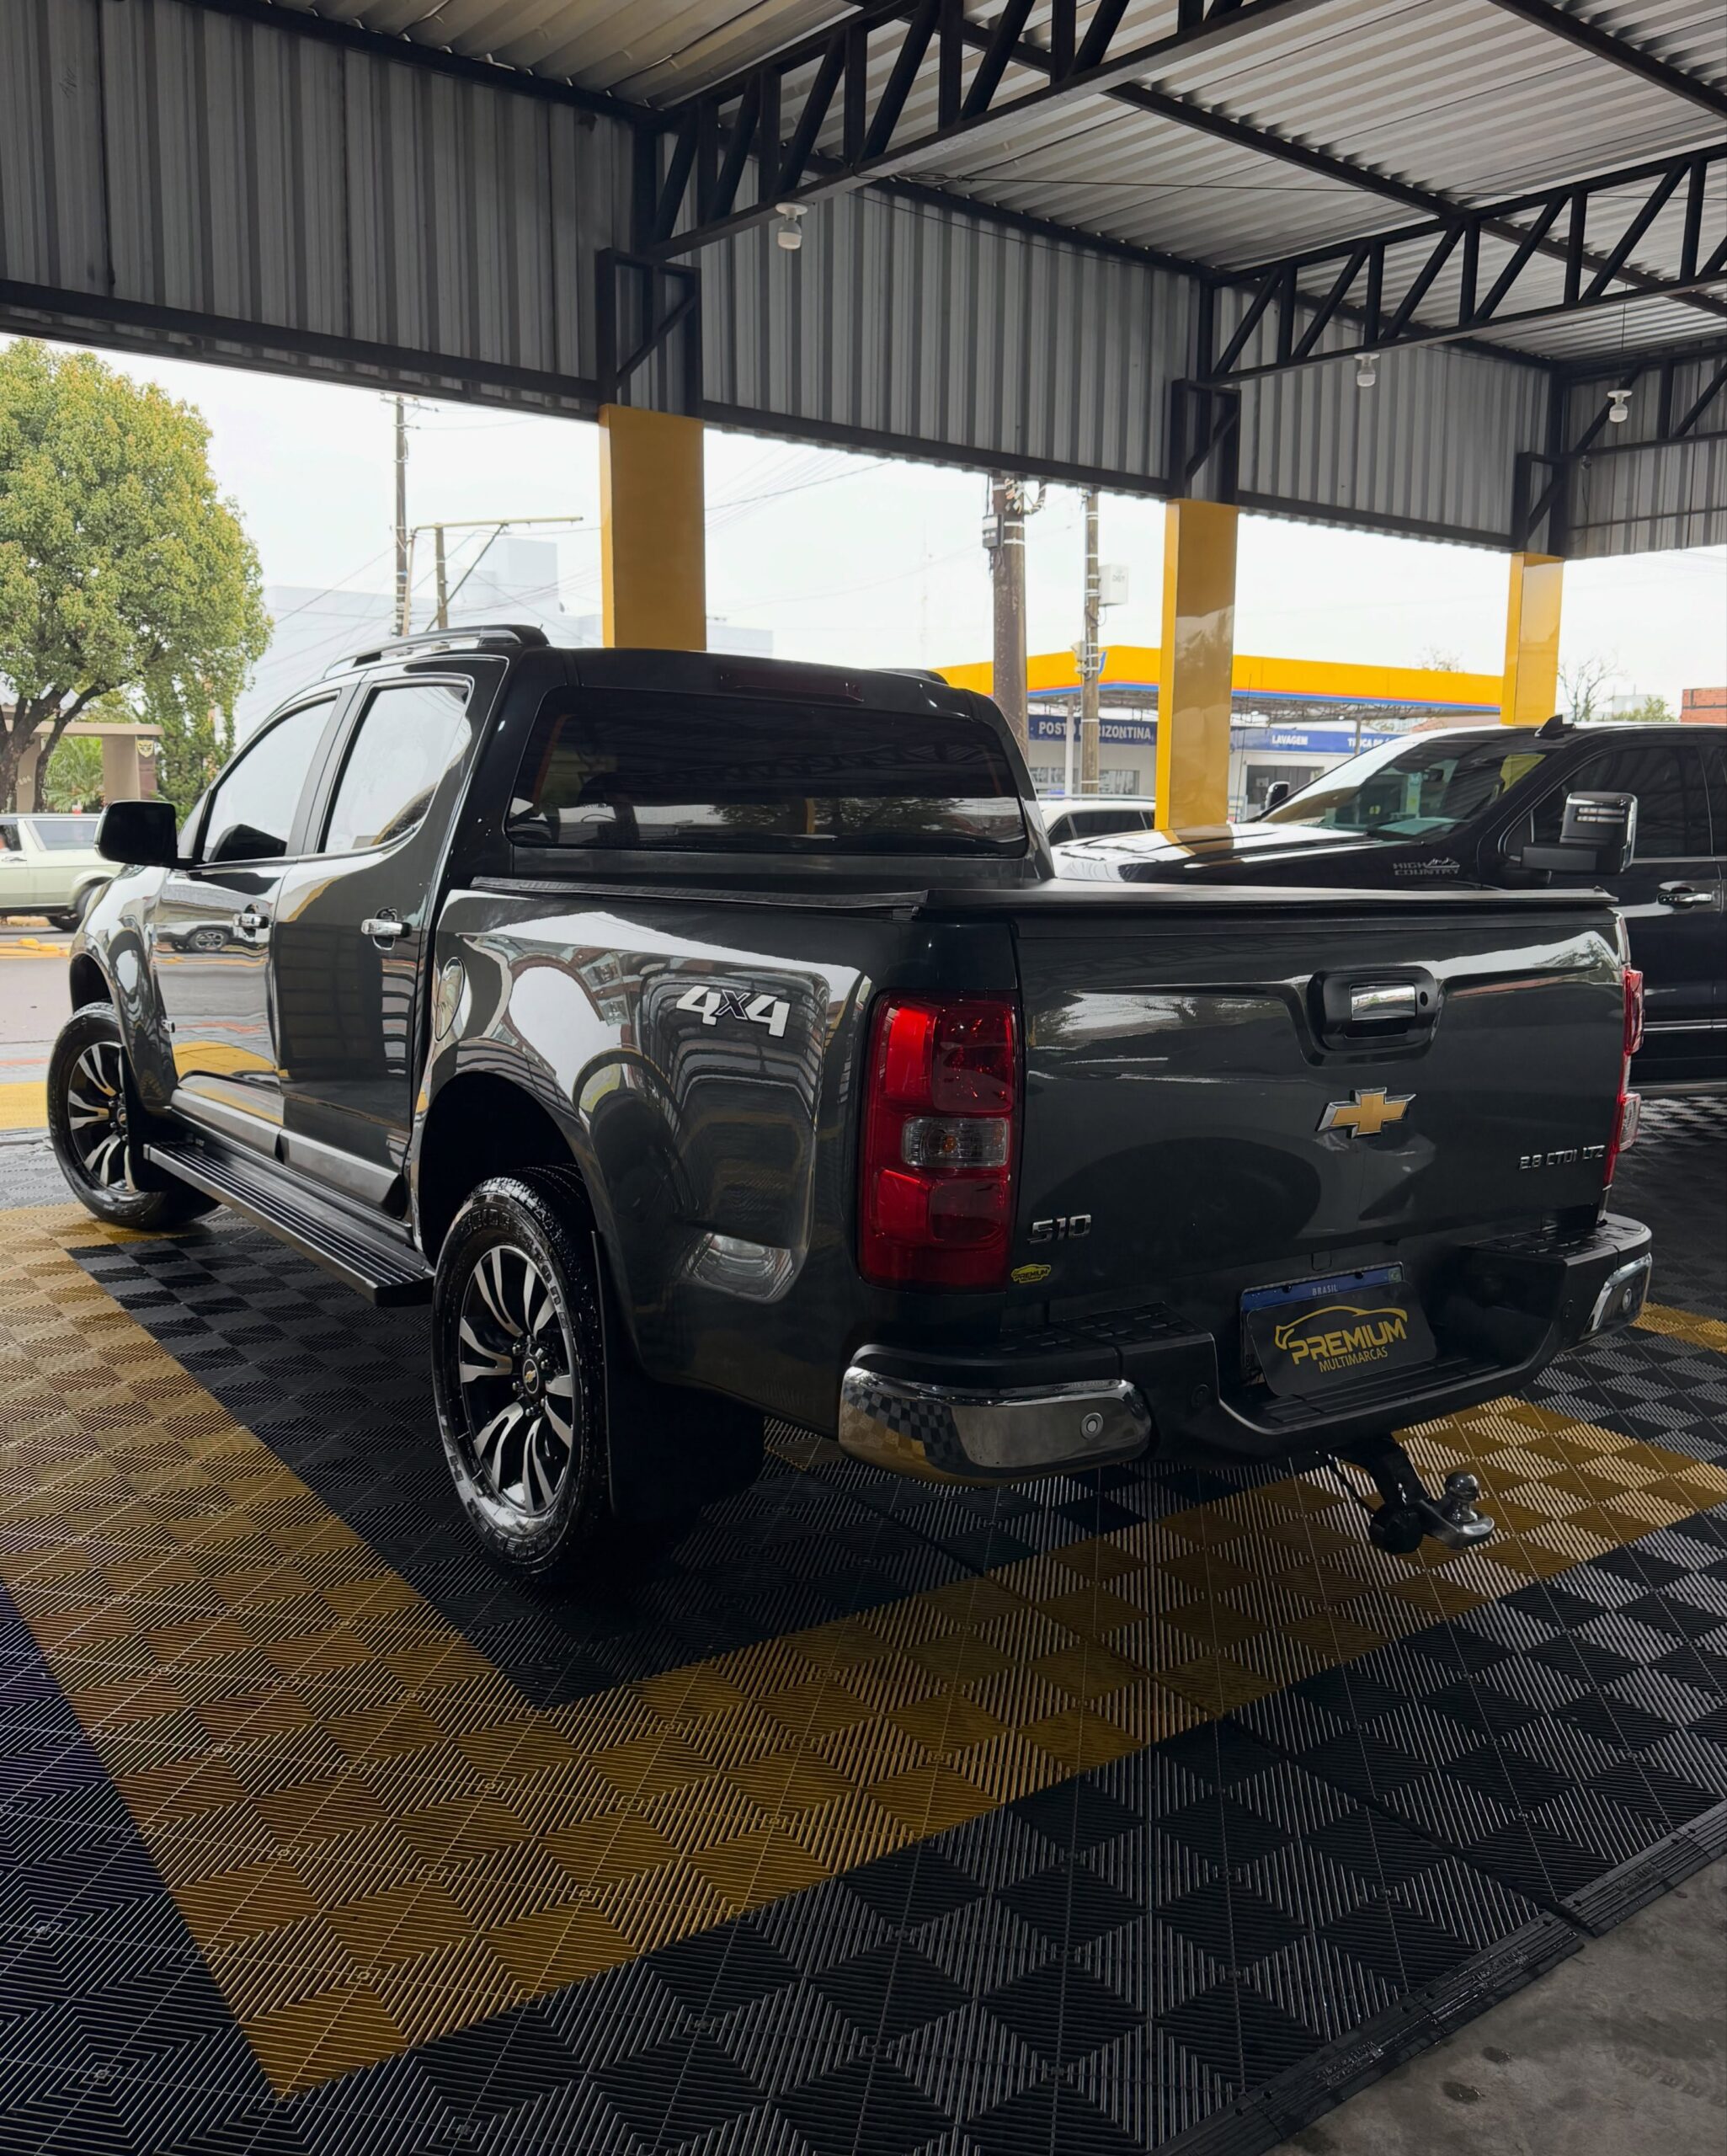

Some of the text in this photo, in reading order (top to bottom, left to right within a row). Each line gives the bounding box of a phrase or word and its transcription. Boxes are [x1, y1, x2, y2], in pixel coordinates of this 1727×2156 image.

[1271, 735, 1308, 745] LAVAGEM
[1027, 1214, 1092, 1245] S10
[1312, 1284, 1339, 1296] BRASIL
[1288, 1318, 1406, 1364] PREMIUM
[1319, 1346, 1389, 1373] MULTIMARCAS
